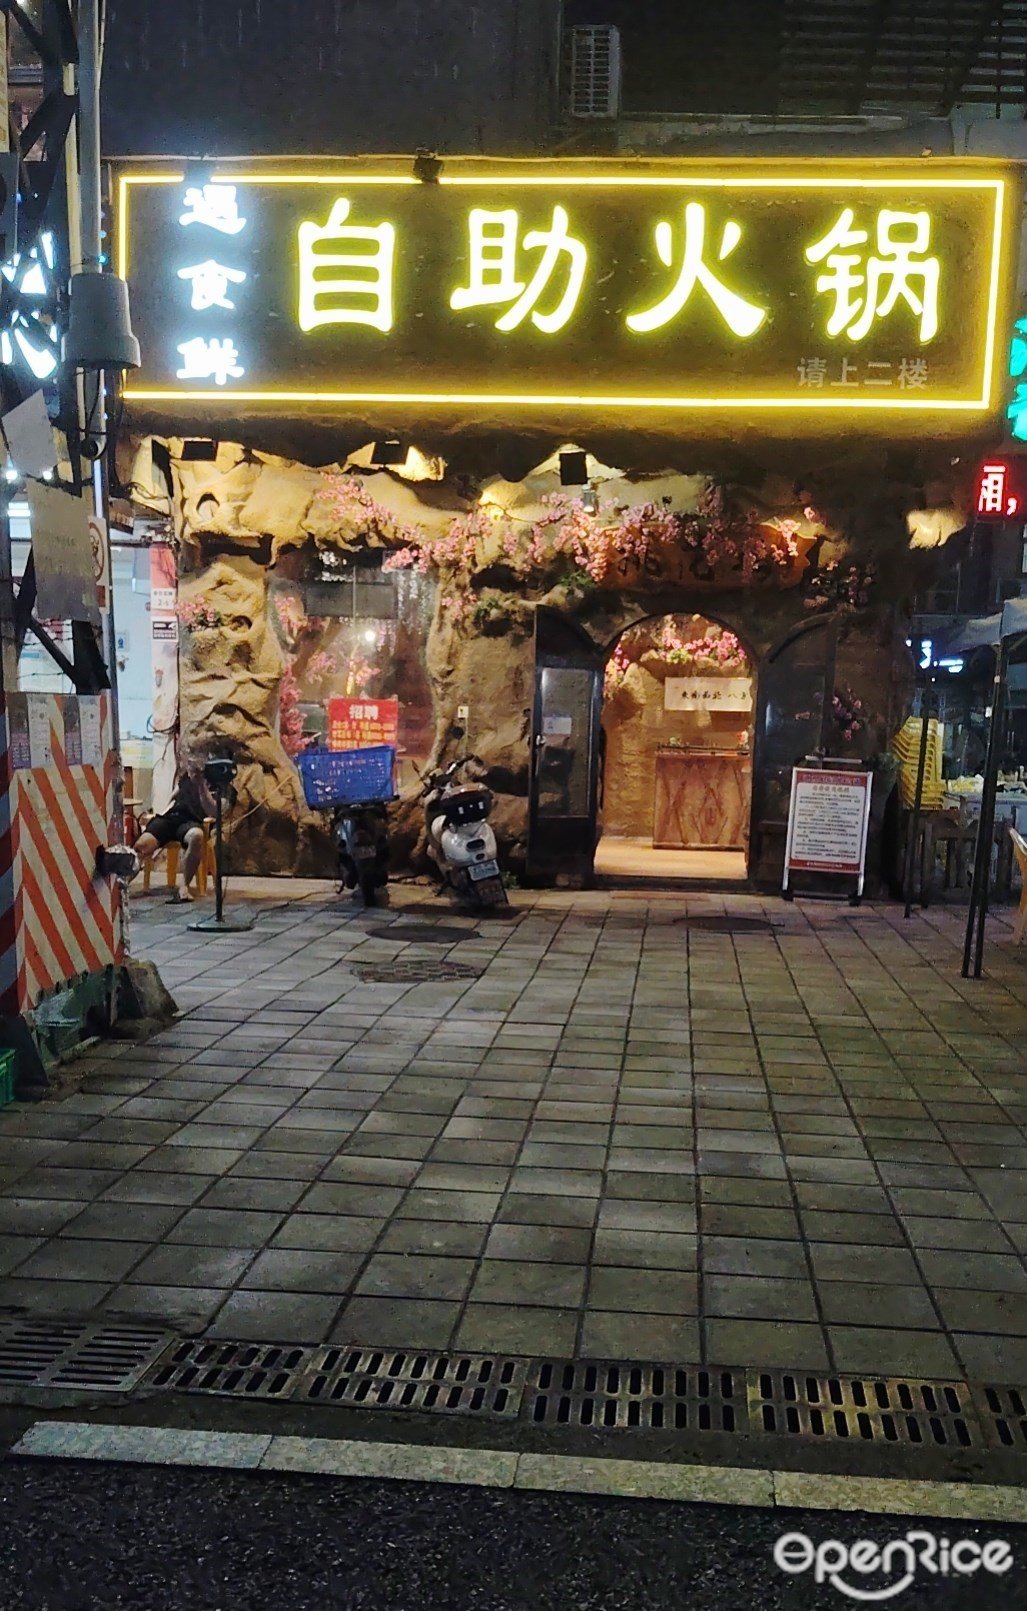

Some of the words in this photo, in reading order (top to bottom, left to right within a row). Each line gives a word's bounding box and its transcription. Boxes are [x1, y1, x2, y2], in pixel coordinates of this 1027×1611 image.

[296, 196, 941, 345] 自助火锅
[797, 356, 929, 390] 请上二楼
[349, 704, 379, 721] 招聘
